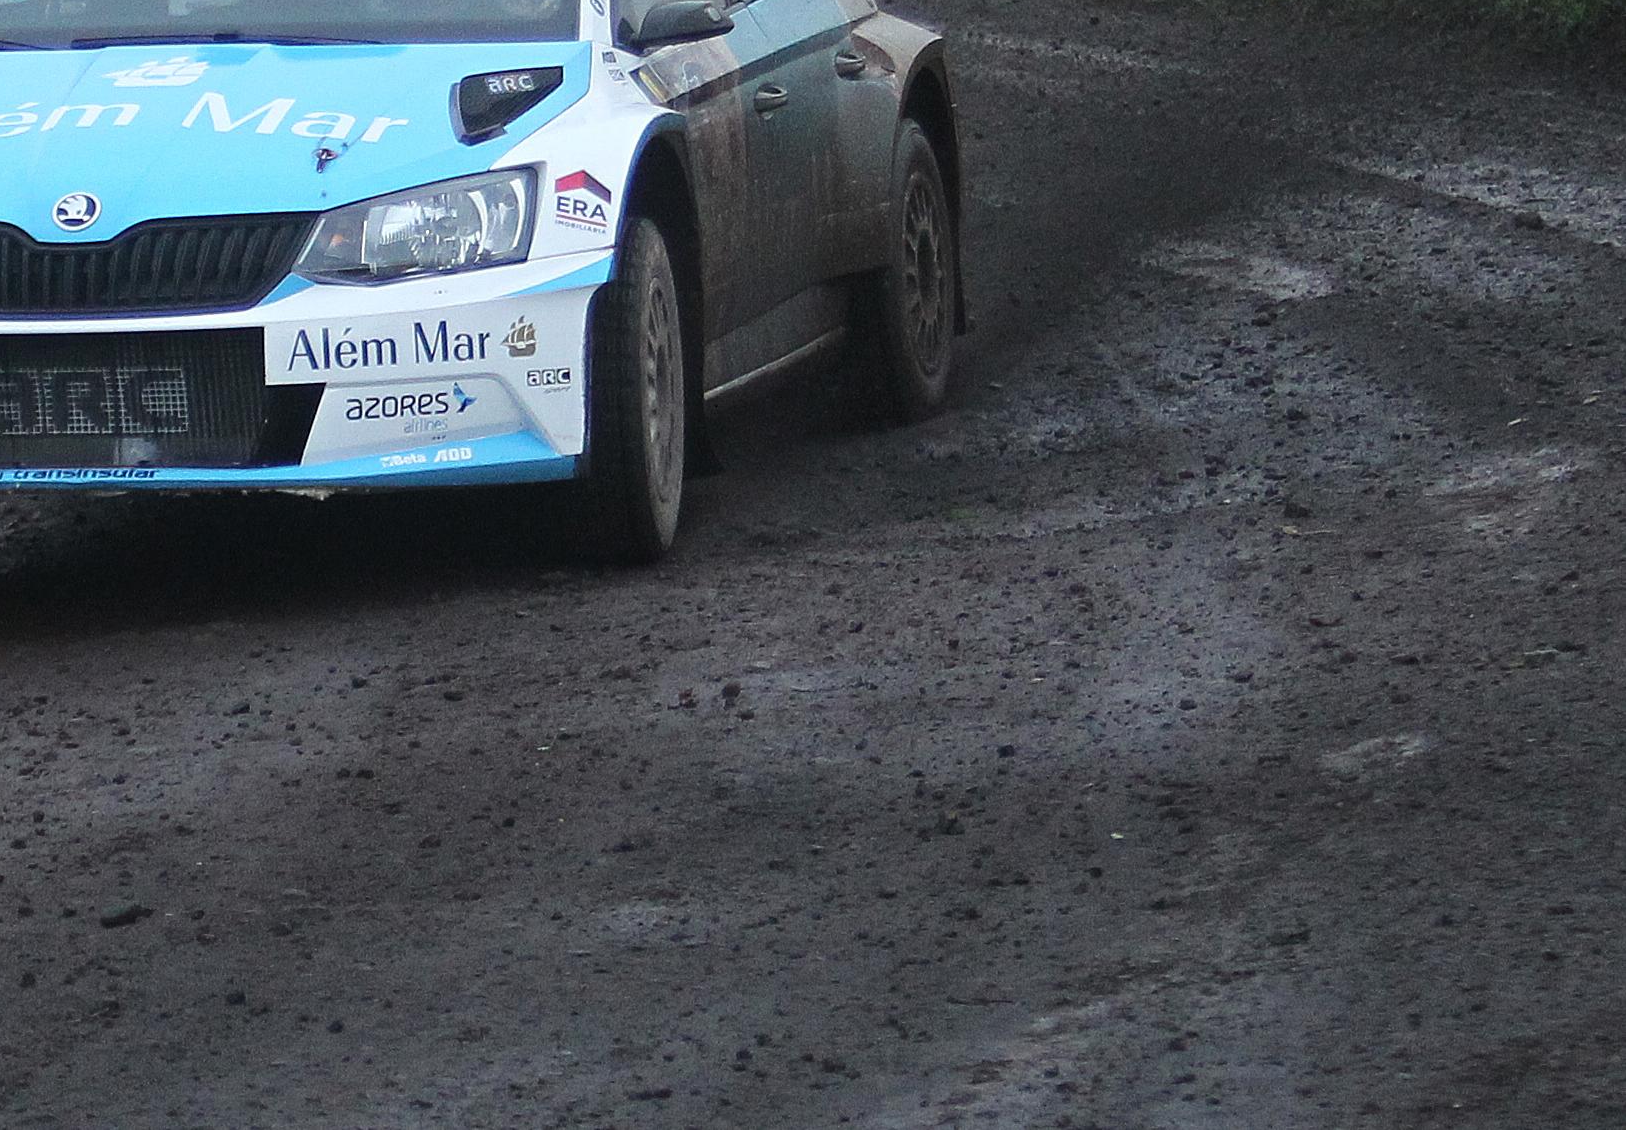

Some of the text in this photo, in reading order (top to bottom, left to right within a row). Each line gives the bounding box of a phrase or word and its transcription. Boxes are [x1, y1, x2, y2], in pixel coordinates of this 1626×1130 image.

[181, 91, 409, 143] Mar
[556, 195, 607, 222] ERA
[288, 320, 490, 371] Além Mar
